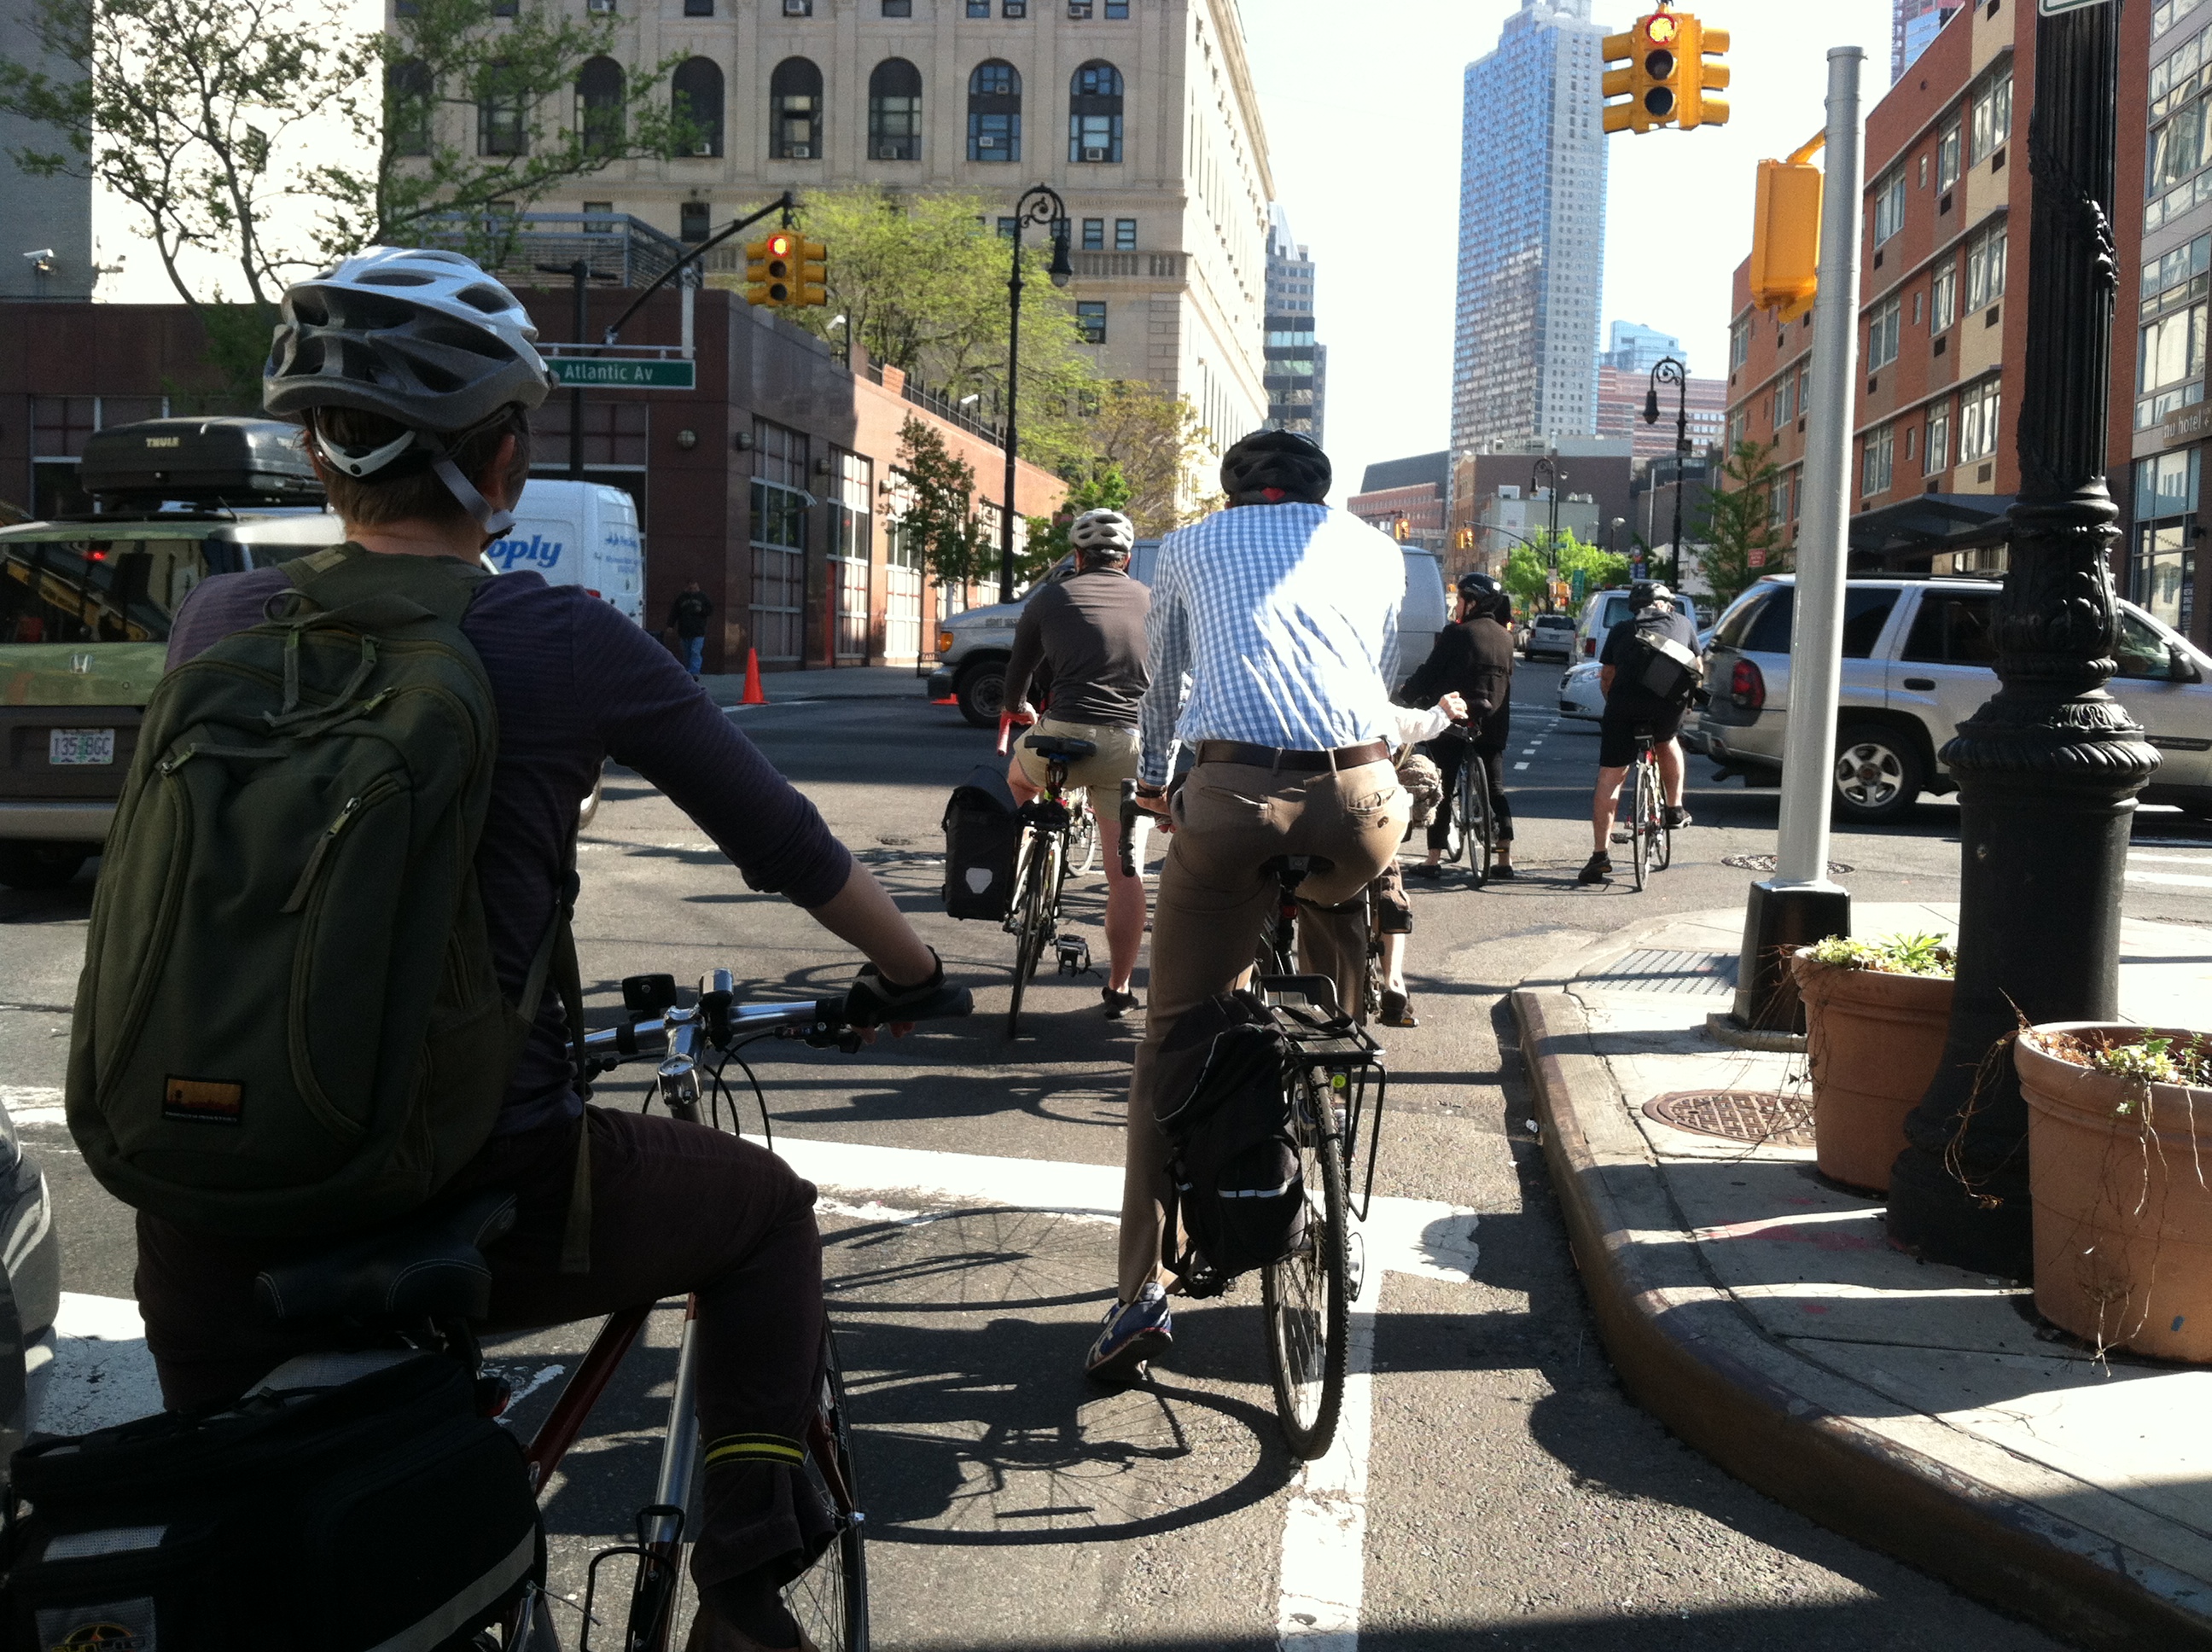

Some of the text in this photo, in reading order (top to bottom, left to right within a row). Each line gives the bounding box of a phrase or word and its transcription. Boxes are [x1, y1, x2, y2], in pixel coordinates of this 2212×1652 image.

[564, 364, 654, 381] Atlantic Av
[2163, 422, 2175, 439] nu
[2178, 409, 2202, 435] hotel
